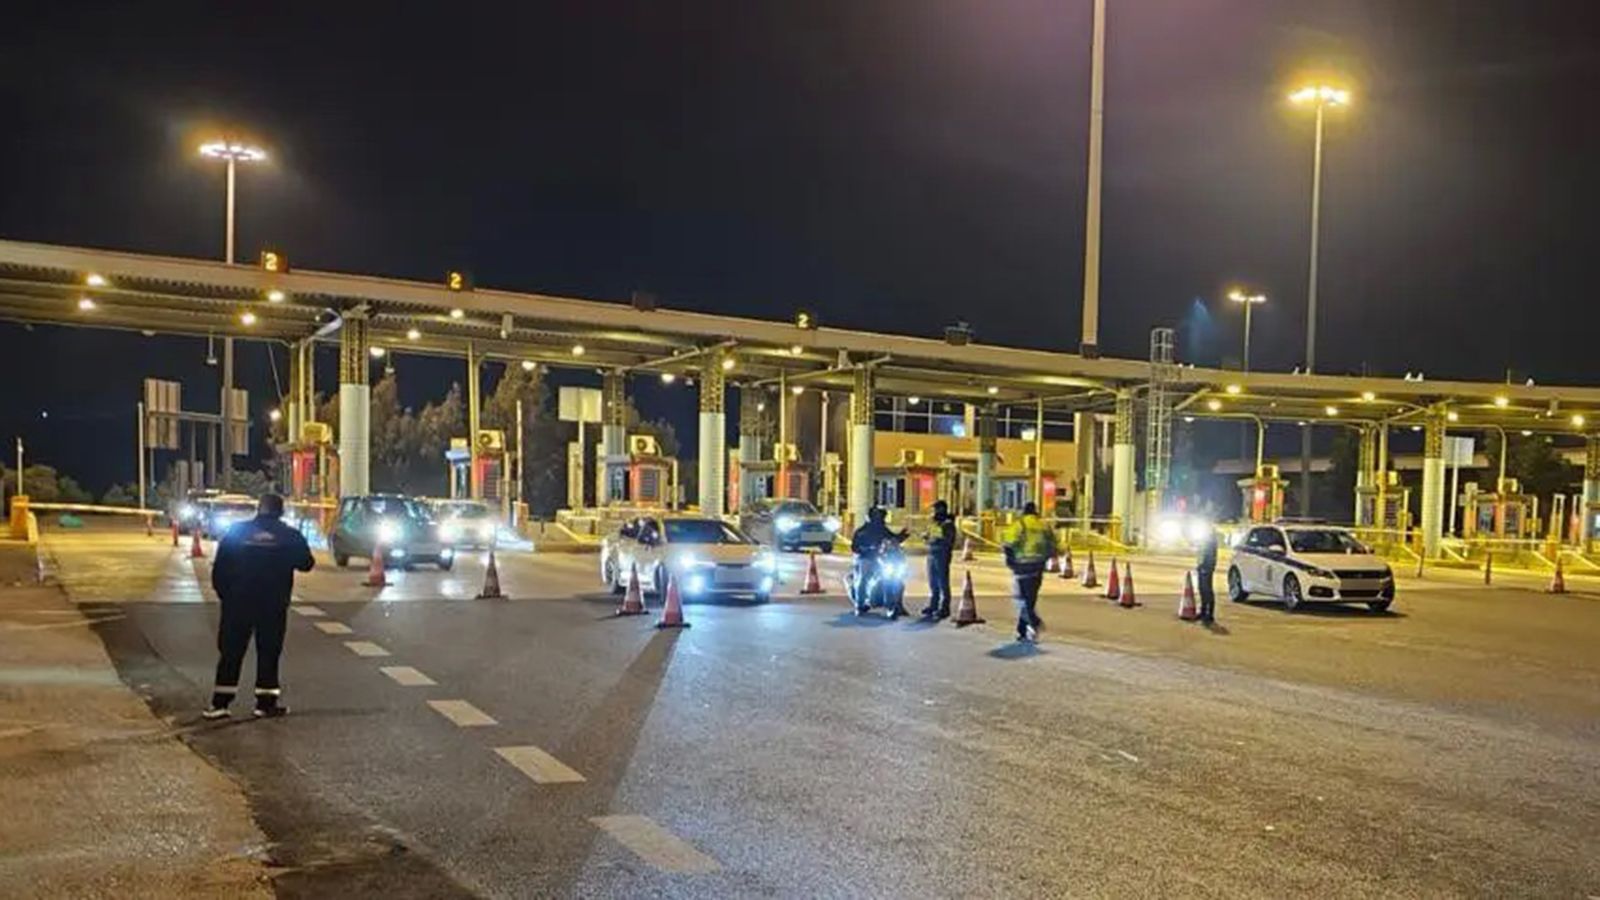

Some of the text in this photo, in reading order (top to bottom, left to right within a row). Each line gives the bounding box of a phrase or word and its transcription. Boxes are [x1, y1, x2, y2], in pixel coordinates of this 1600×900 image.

[265, 252, 278, 271] 2
[450, 272, 461, 289] 2
[798, 313, 808, 328] 2
